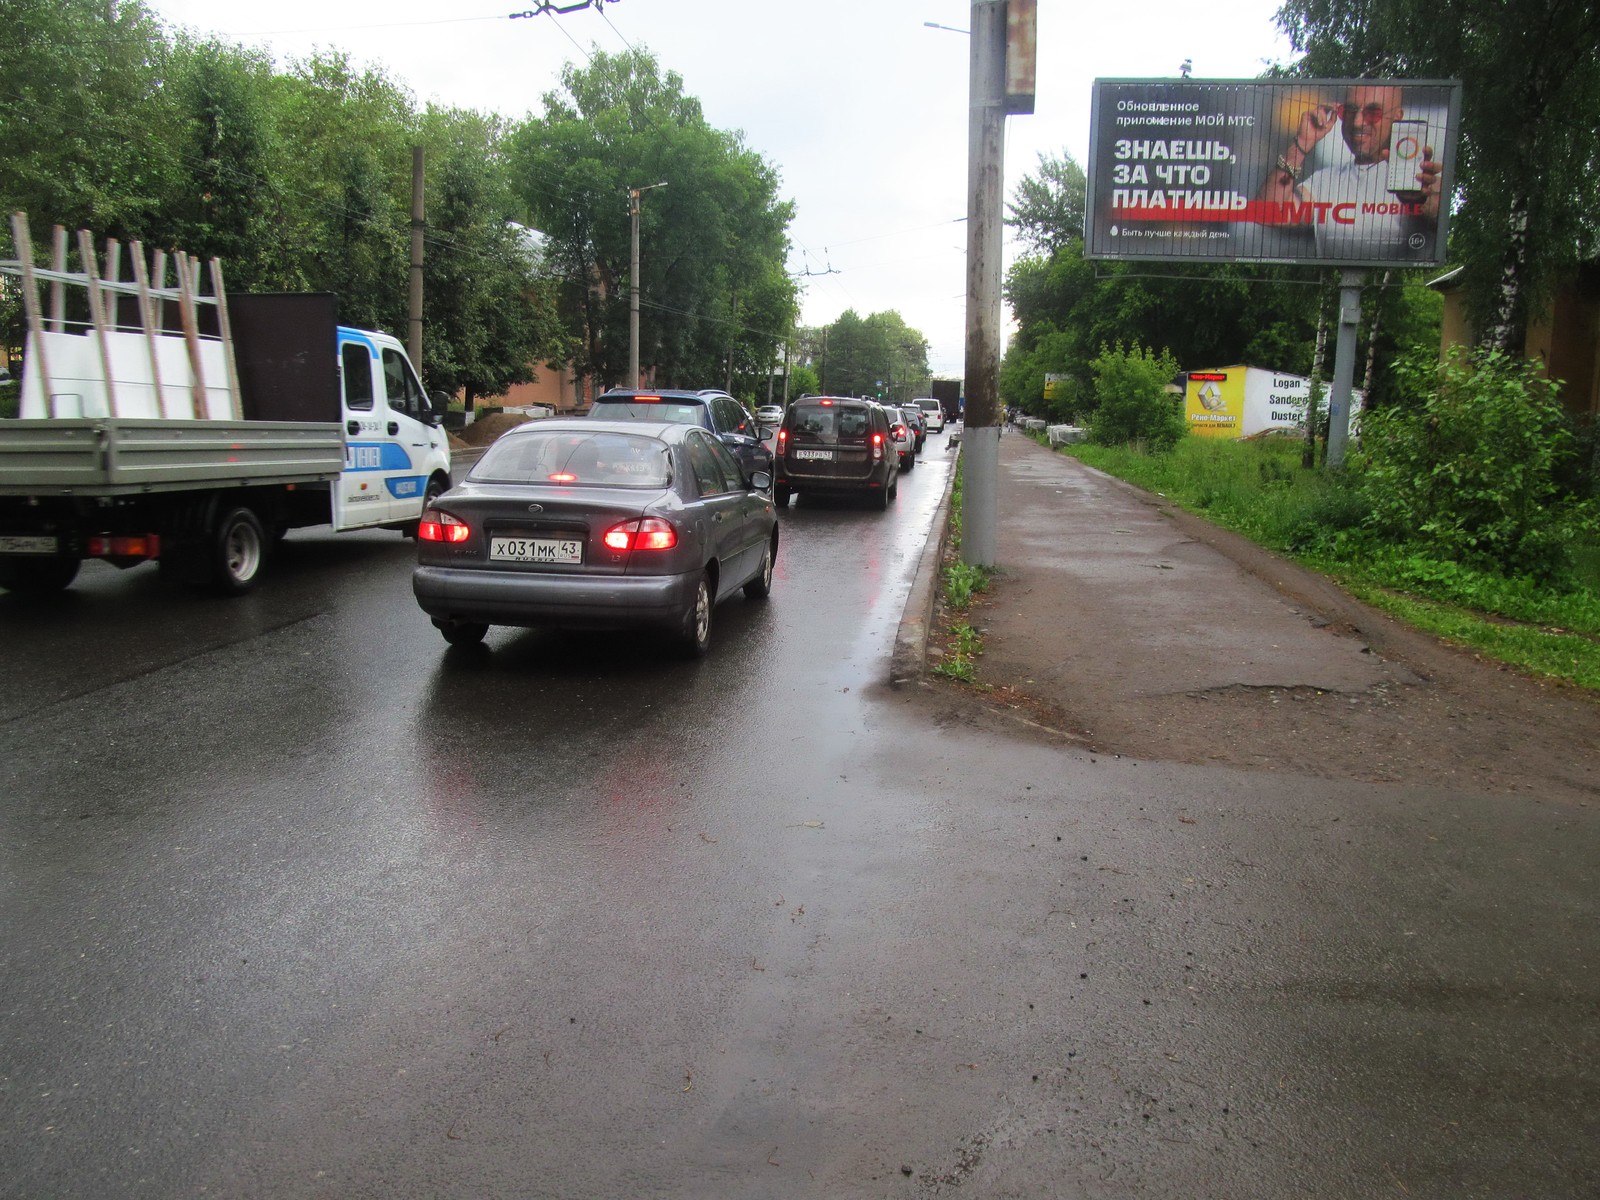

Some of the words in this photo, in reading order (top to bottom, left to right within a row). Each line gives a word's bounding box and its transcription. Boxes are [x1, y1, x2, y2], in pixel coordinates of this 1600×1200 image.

[1116, 100, 1199, 112] Обновленное
[1116, 116, 1192, 127] приложение
[1195, 113, 1225, 126] МОЙ
[1227, 115, 1256, 126] МТС
[1114, 139, 1237, 164] ЗНАЕШЬ,
[1112, 164, 1148, 184] ЗА
[1155, 165, 1210, 185] ЧТО
[1112, 189, 1248, 211] ПЛАТИШЬ
[1361, 203, 1425, 216] MOBILE
[1121, 228, 1143, 237] Быть
[1144, 229, 1172, 239] лучше
[1173, 229, 1207, 239] каждый
[1208, 231, 1230, 240] день
[1273, 378, 1301, 390] Logan
[1271, 411, 1302, 421] Duster
